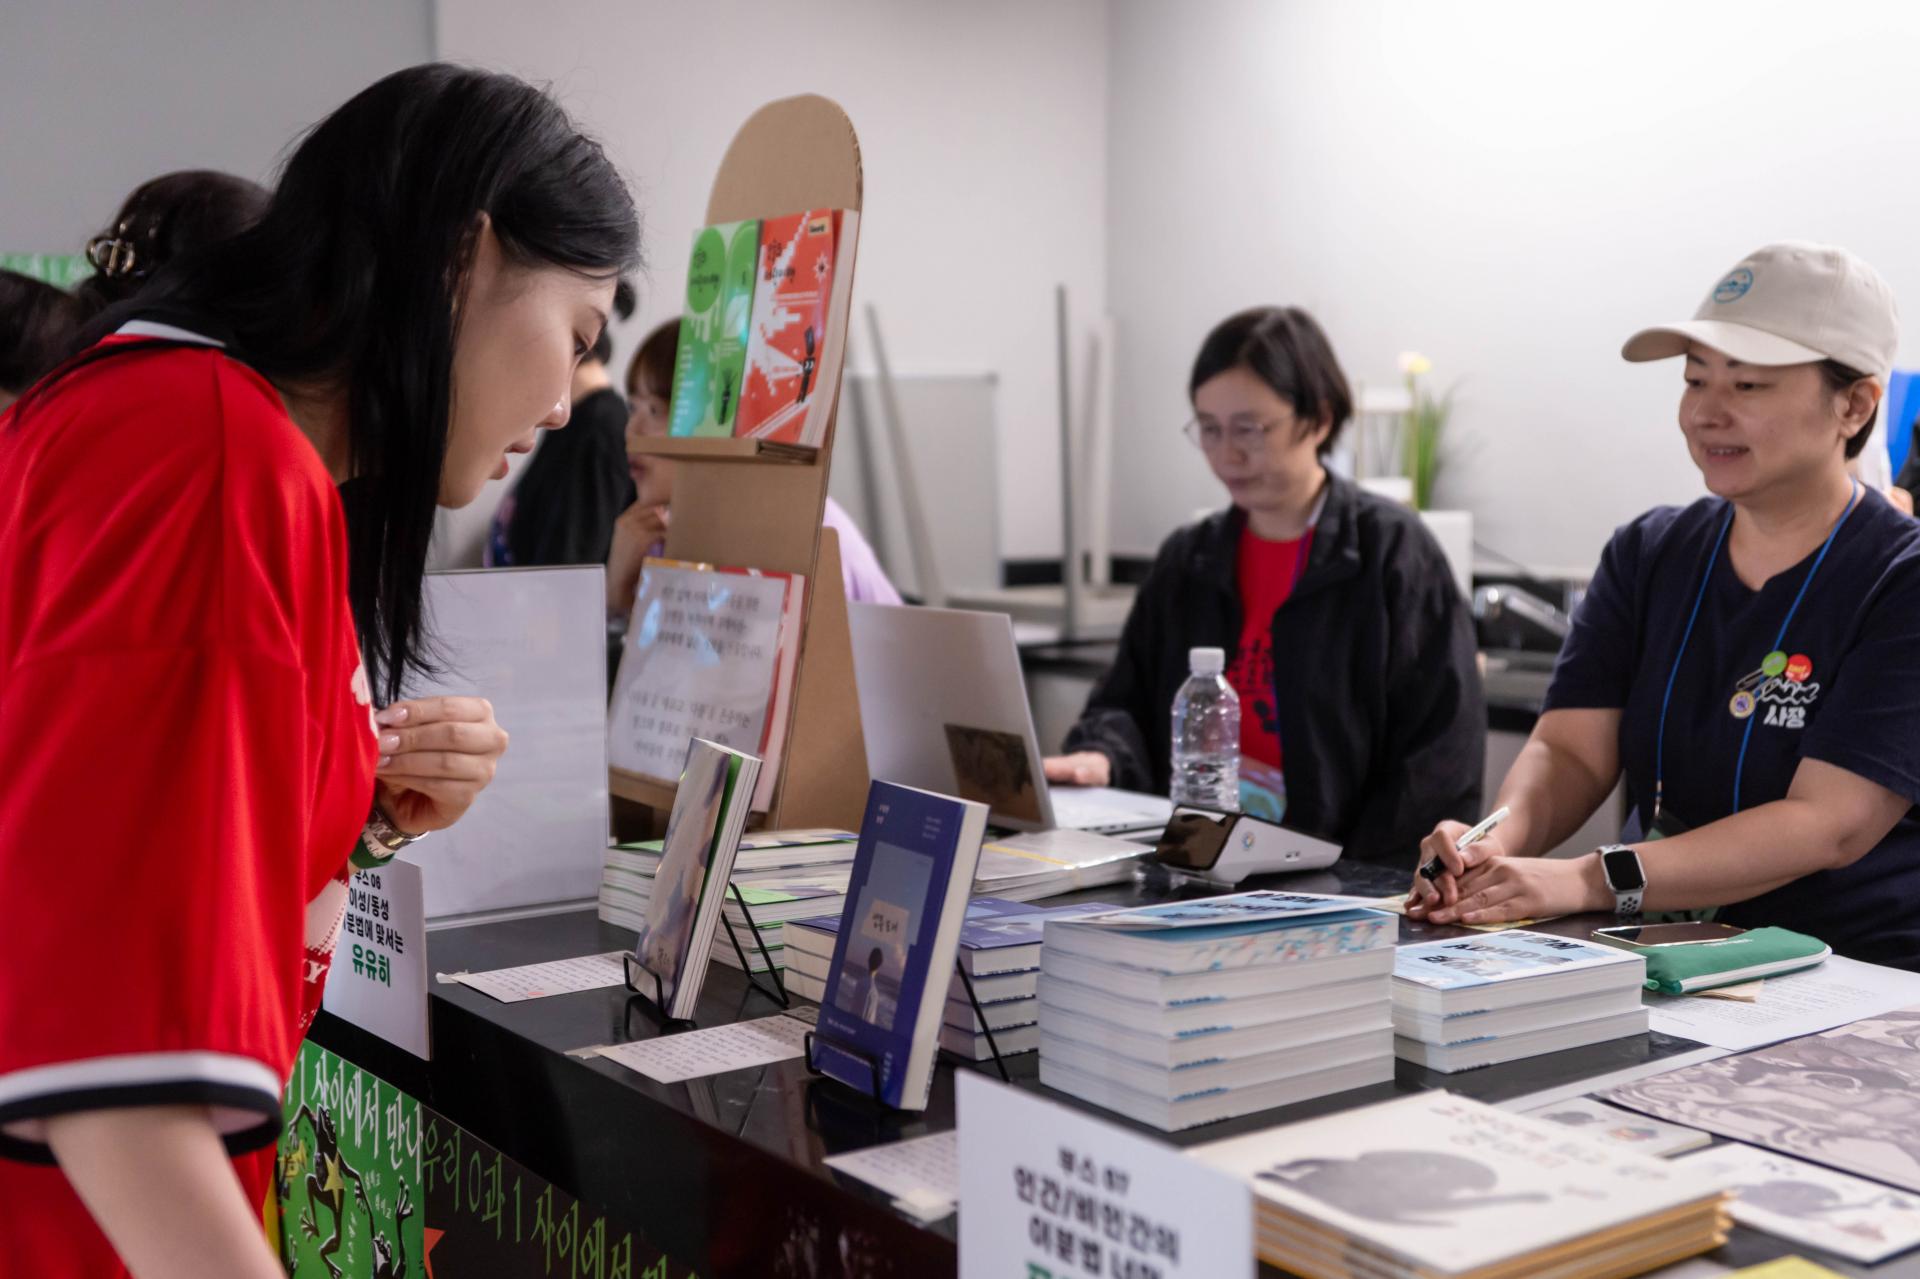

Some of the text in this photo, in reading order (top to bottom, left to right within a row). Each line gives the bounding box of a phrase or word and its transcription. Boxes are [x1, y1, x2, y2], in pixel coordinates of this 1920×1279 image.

[349, 887, 389, 921] 이성/동성
[371, 874, 381, 890] 06
[375, 923, 404, 954] 맞서는
[352, 943, 391, 988] 유유히
[311, 1049, 380, 1159] 사이에서
[385, 1090, 423, 1185] 만나
[422, 1118, 461, 1212] 우리
[468, 1150, 505, 1240] 0과
[1058, 1147, 1096, 1186] 부스
[1013, 1165, 1182, 1267] 인간/비인간의
[1028, 1214, 1104, 1277] 이분법
